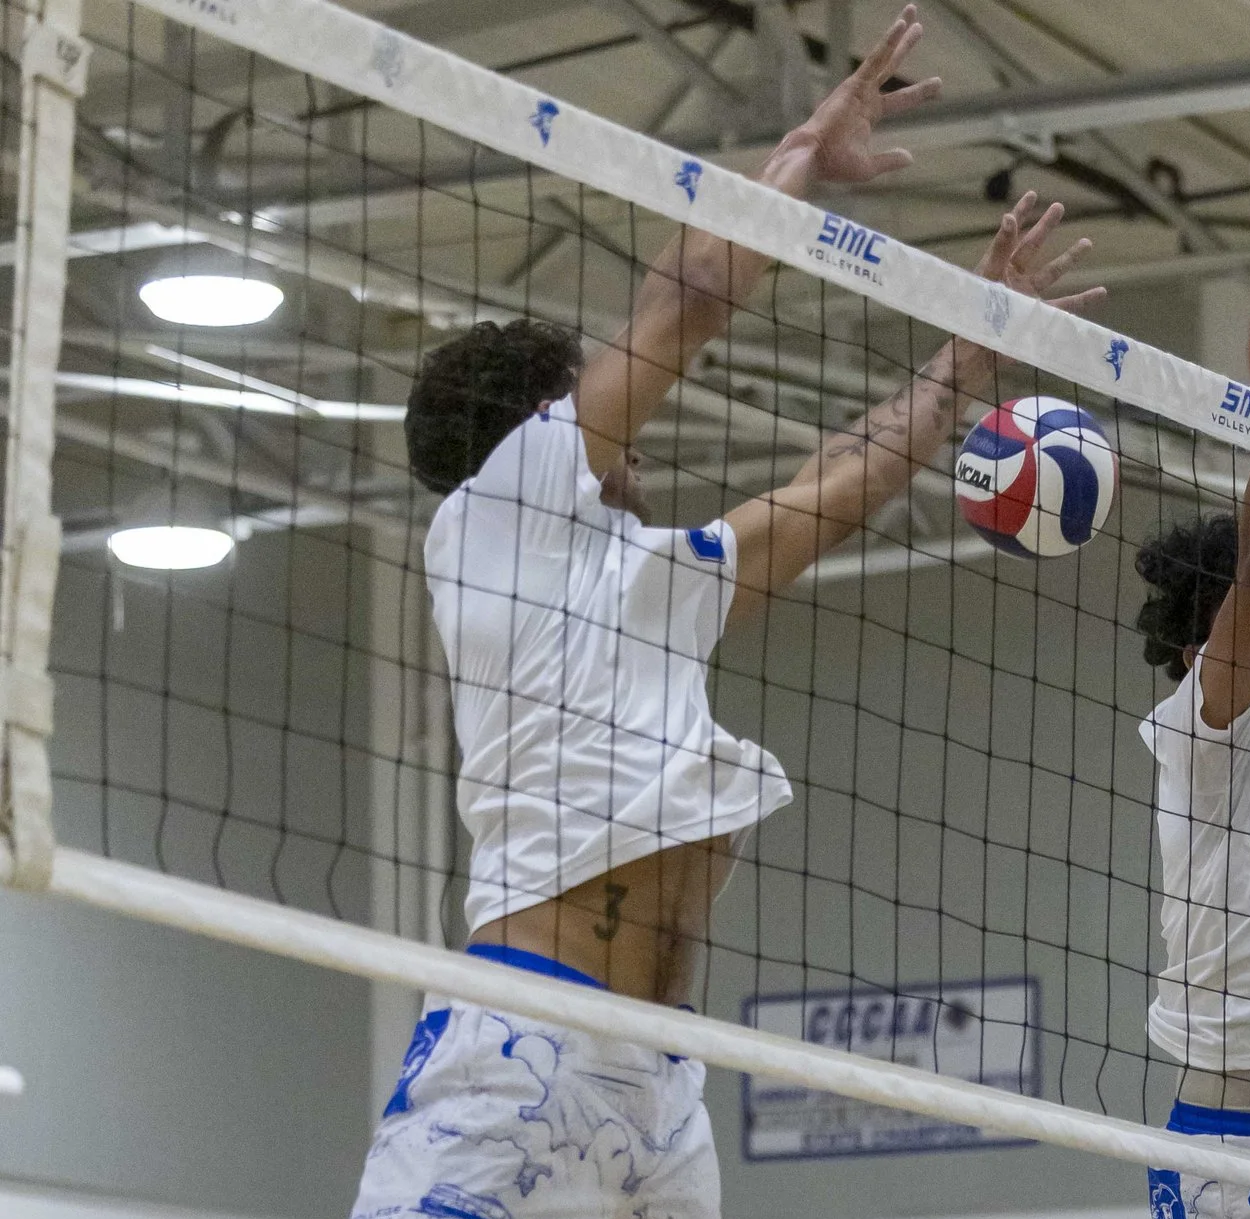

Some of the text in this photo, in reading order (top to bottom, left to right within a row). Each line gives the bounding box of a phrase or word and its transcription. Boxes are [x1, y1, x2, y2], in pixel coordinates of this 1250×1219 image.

[817, 211, 887, 266] SMC
[806, 245, 883, 287] VOLLEYBALL
[957, 460, 991, 492] NCAA
